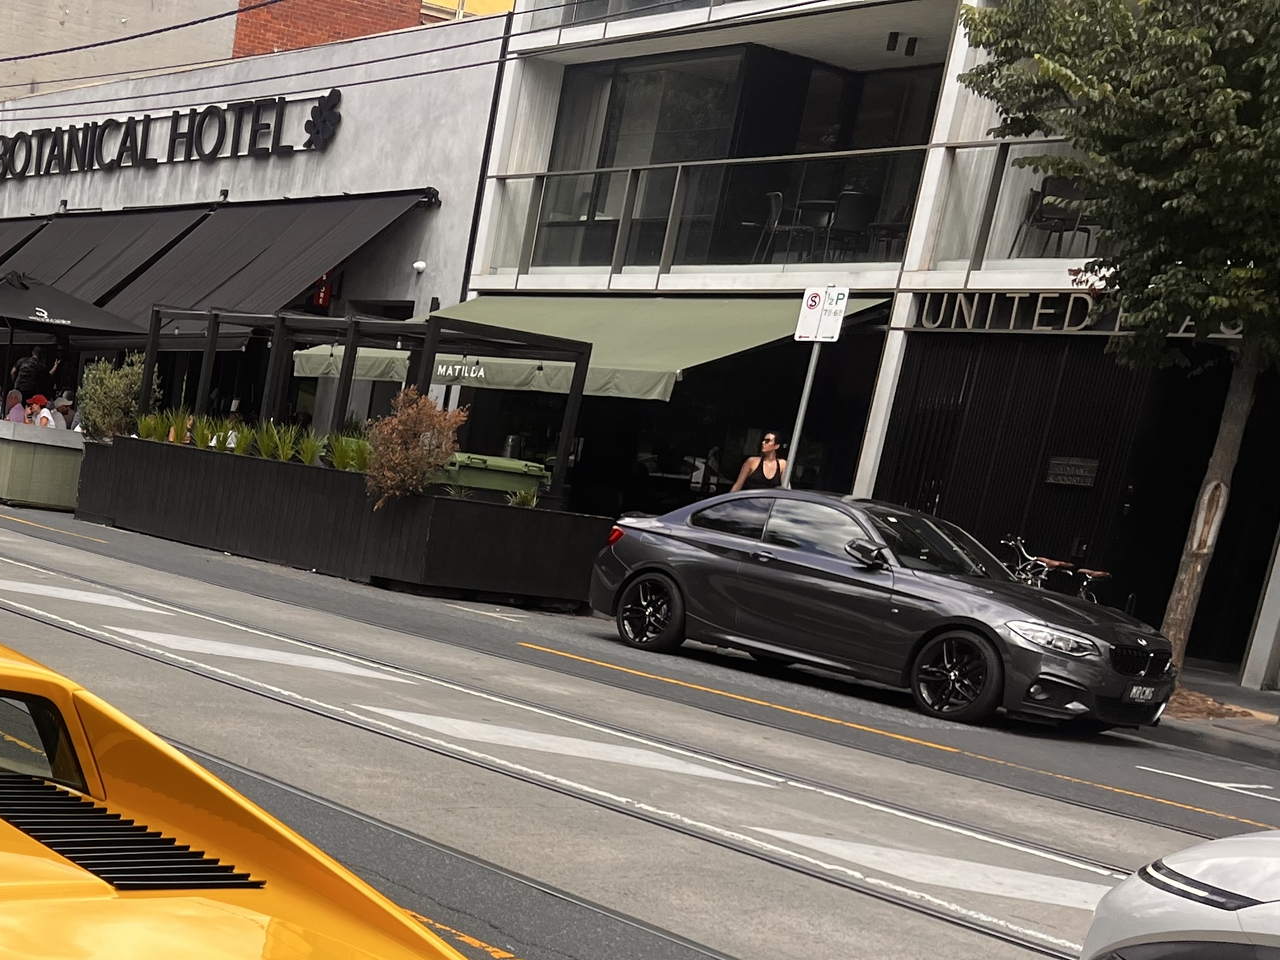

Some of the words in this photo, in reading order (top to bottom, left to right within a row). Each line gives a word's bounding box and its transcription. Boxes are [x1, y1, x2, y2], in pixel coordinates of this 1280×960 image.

[170, 97, 294, 163] HOTEL
[921, 292, 1095, 332] UNITED
[437, 364, 485, 378] MATILDA
